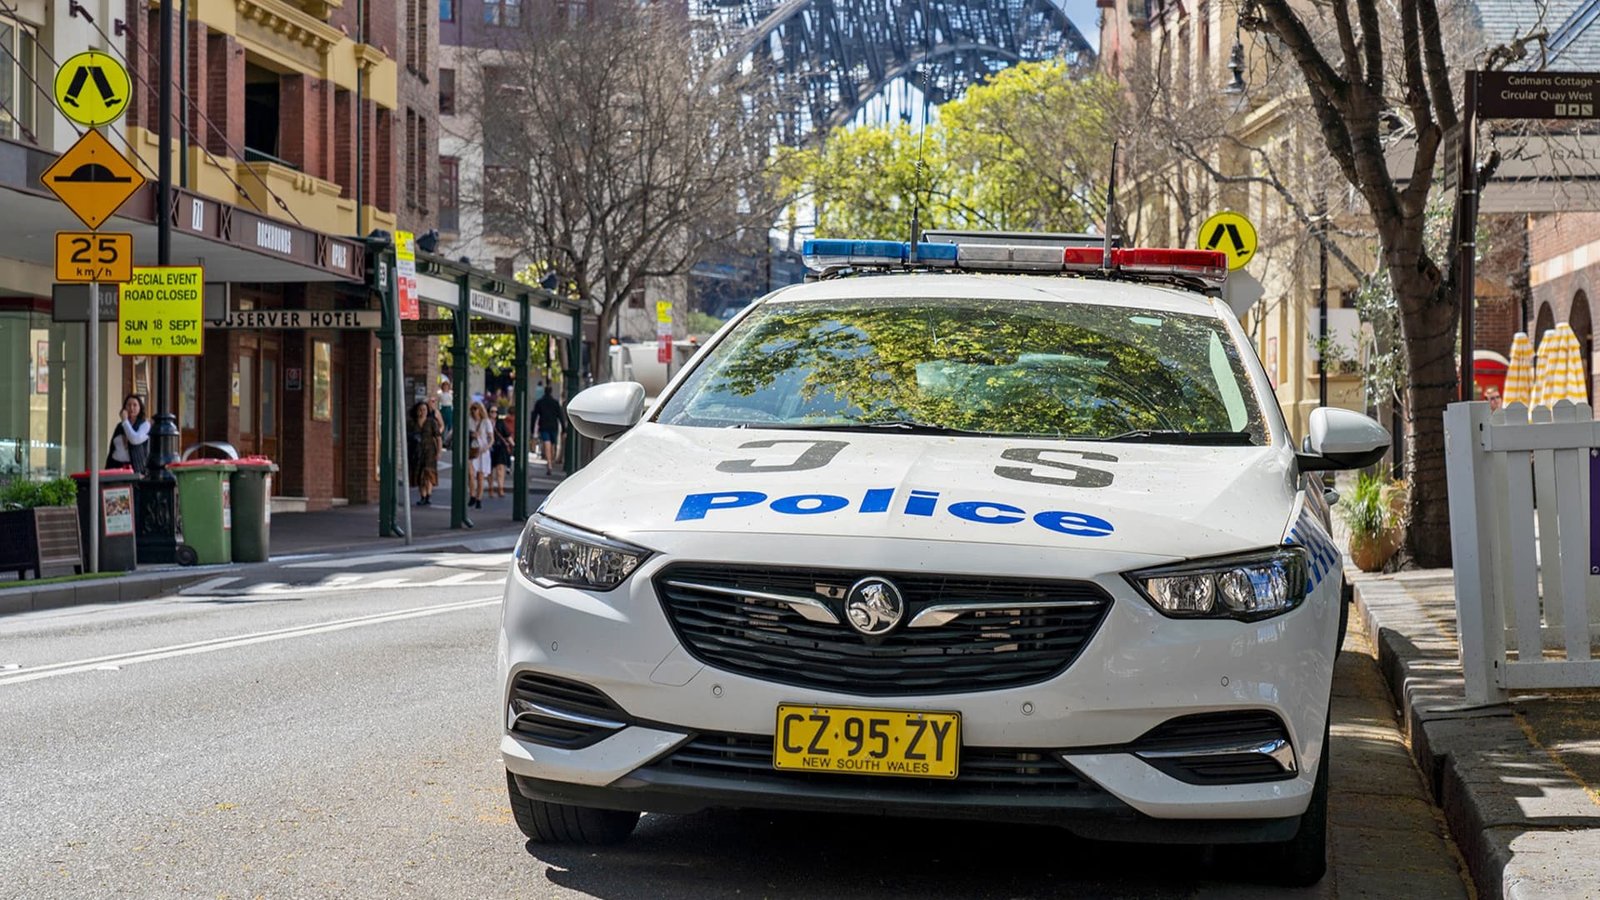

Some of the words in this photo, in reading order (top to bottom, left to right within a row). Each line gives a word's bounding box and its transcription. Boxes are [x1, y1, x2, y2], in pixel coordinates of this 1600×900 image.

[1508, 76, 1551, 86] Cadmans
[1554, 76, 1593, 88] Cottage
[1501, 90, 1537, 100] Circular
[1540, 91, 1565, 102] Quay
[1568, 91, 1593, 100] West
[70, 238, 118, 264] 25
[76, 267, 112, 278] km/h
[167, 273, 197, 285] EVENT
[125, 290, 154, 301] ROAD
[156, 290, 197, 301] CLOSED
[125, 320, 148, 331] SUN
[153, 319, 163, 330] 18
[169, 320, 197, 331] SEPT
[311, 312, 361, 327] HOTEL
[125, 335, 142, 346] 4AM
[152, 338, 162, 346] TO
[994, 448, 1118, 488] S
[675, 488, 1114, 537] Police
[802, 757, 832, 768] NEW
[837, 758, 880, 770] SOUTH
[887, 761, 930, 773] WALES
